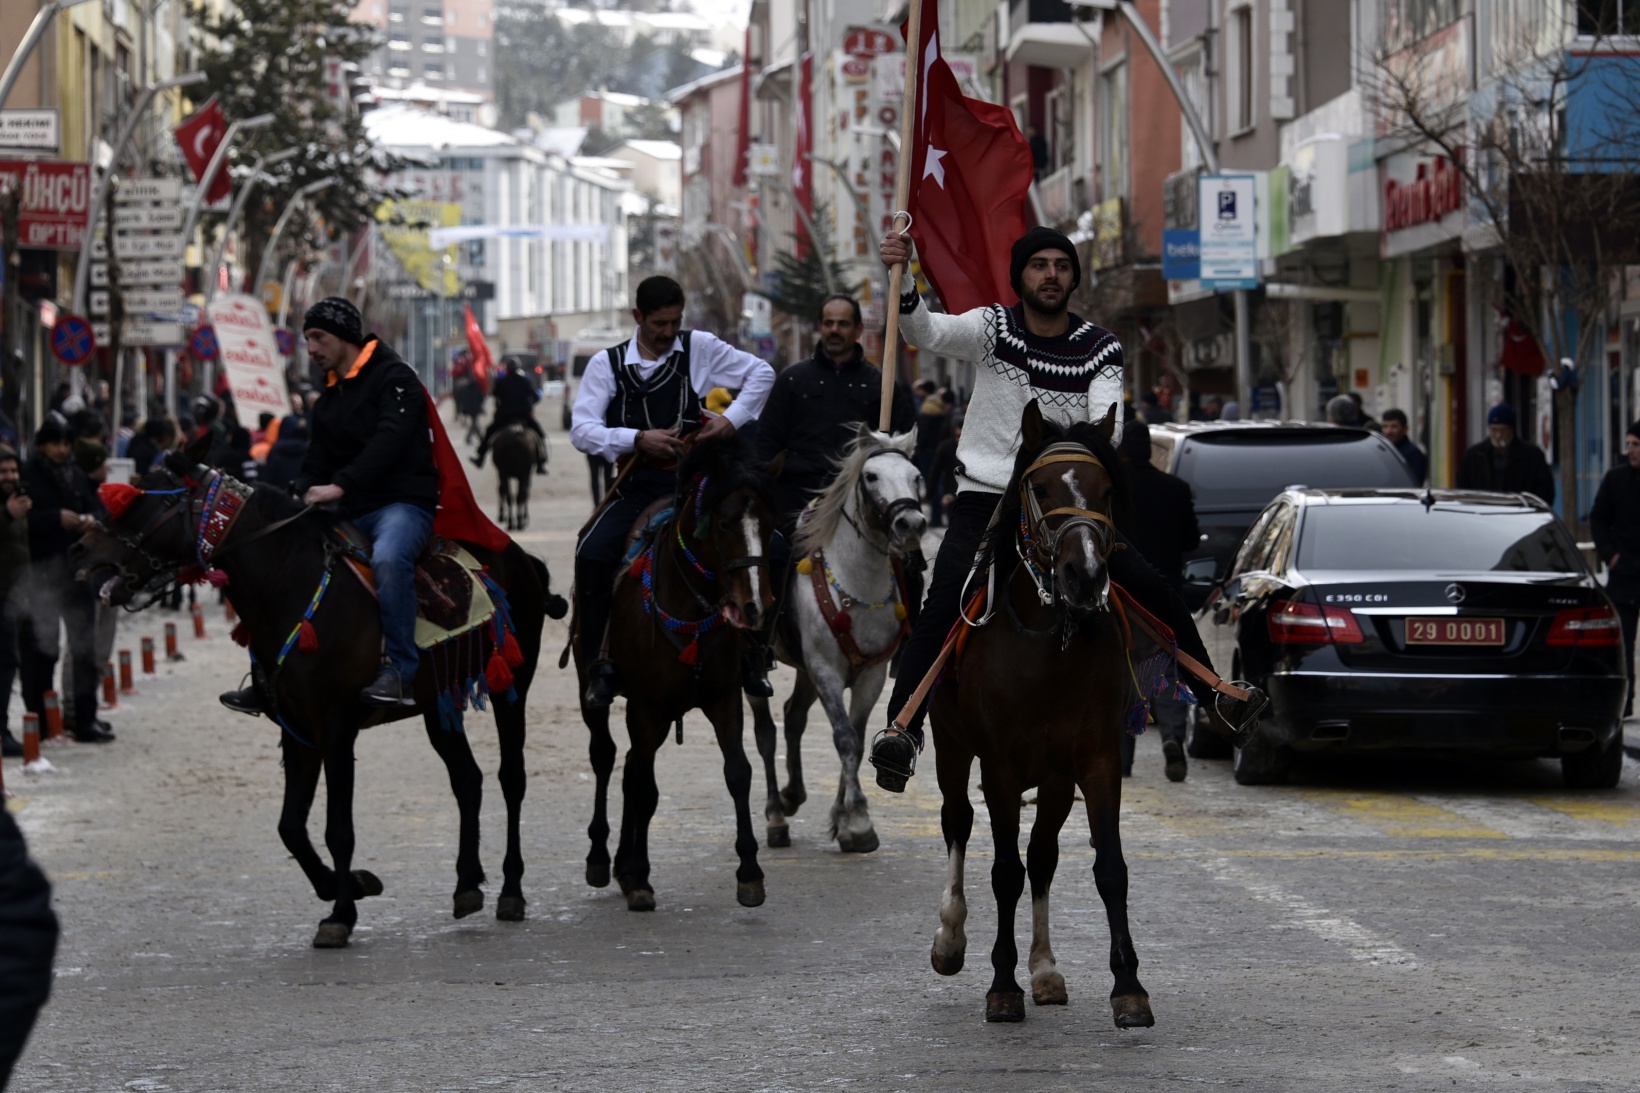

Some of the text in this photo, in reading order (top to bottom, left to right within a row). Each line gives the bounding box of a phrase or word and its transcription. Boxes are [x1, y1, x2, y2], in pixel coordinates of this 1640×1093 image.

[1326, 594, 1388, 602] E 350 CDI
[1413, 622, 1497, 640] 29 0001
